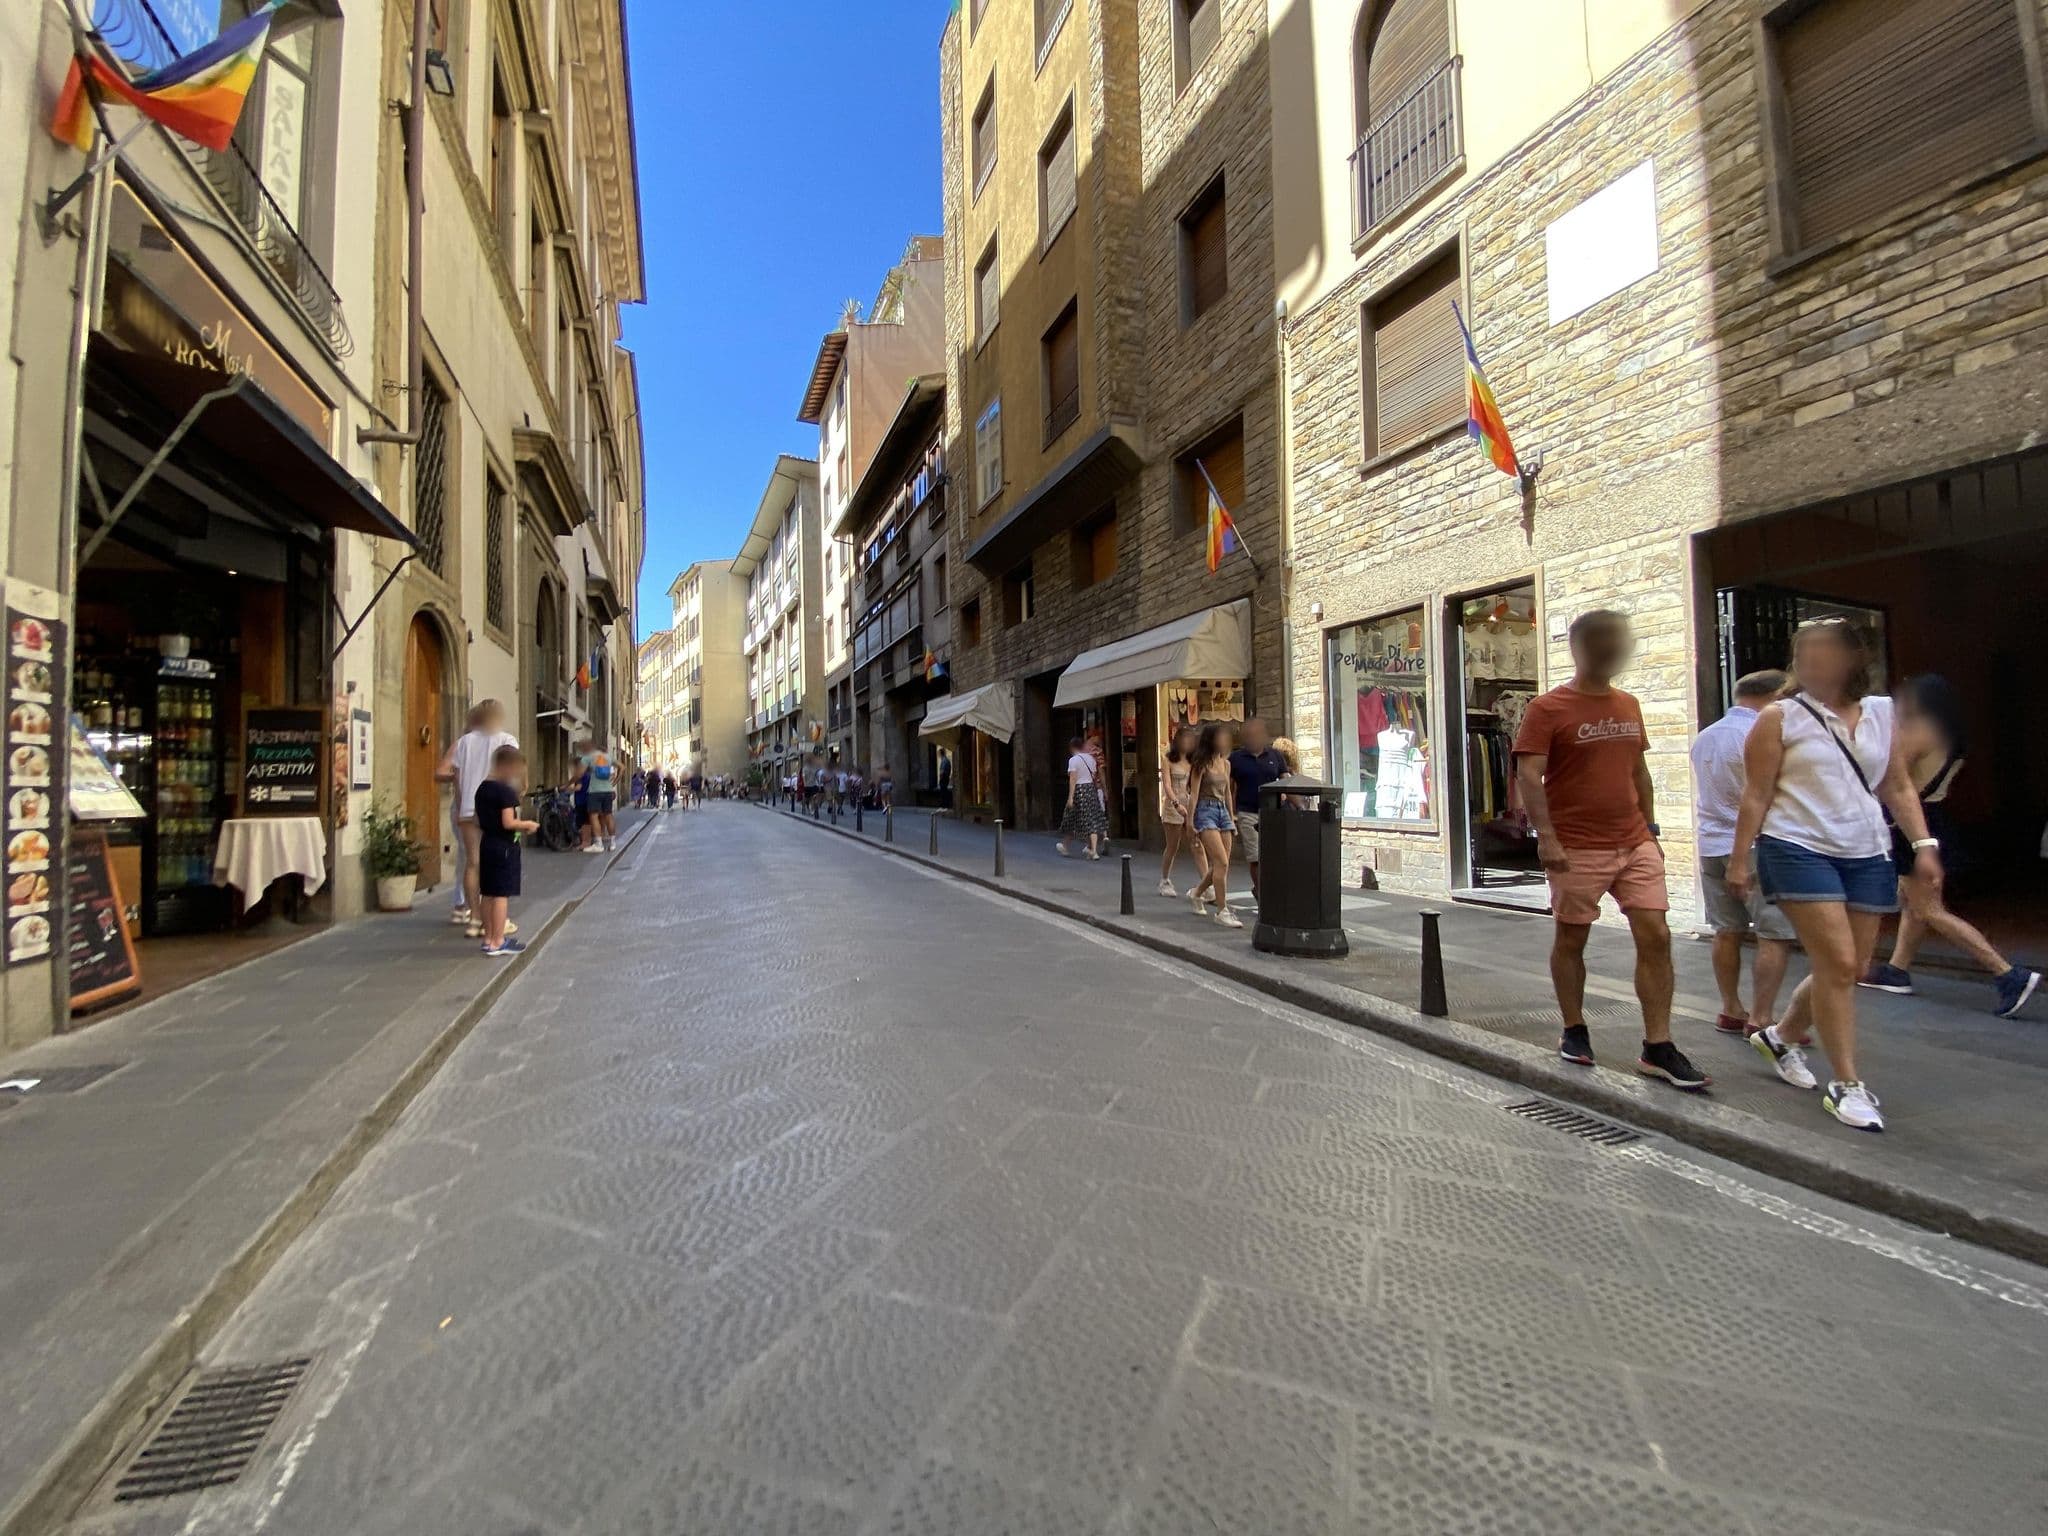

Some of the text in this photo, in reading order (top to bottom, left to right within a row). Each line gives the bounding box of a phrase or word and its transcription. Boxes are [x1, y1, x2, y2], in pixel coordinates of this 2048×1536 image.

[1388, 643, 1402, 659] Di
[1333, 652, 1357, 668] Per
[1394, 657, 1425, 672] Dire
[246, 761, 315, 778] APERITIVI
